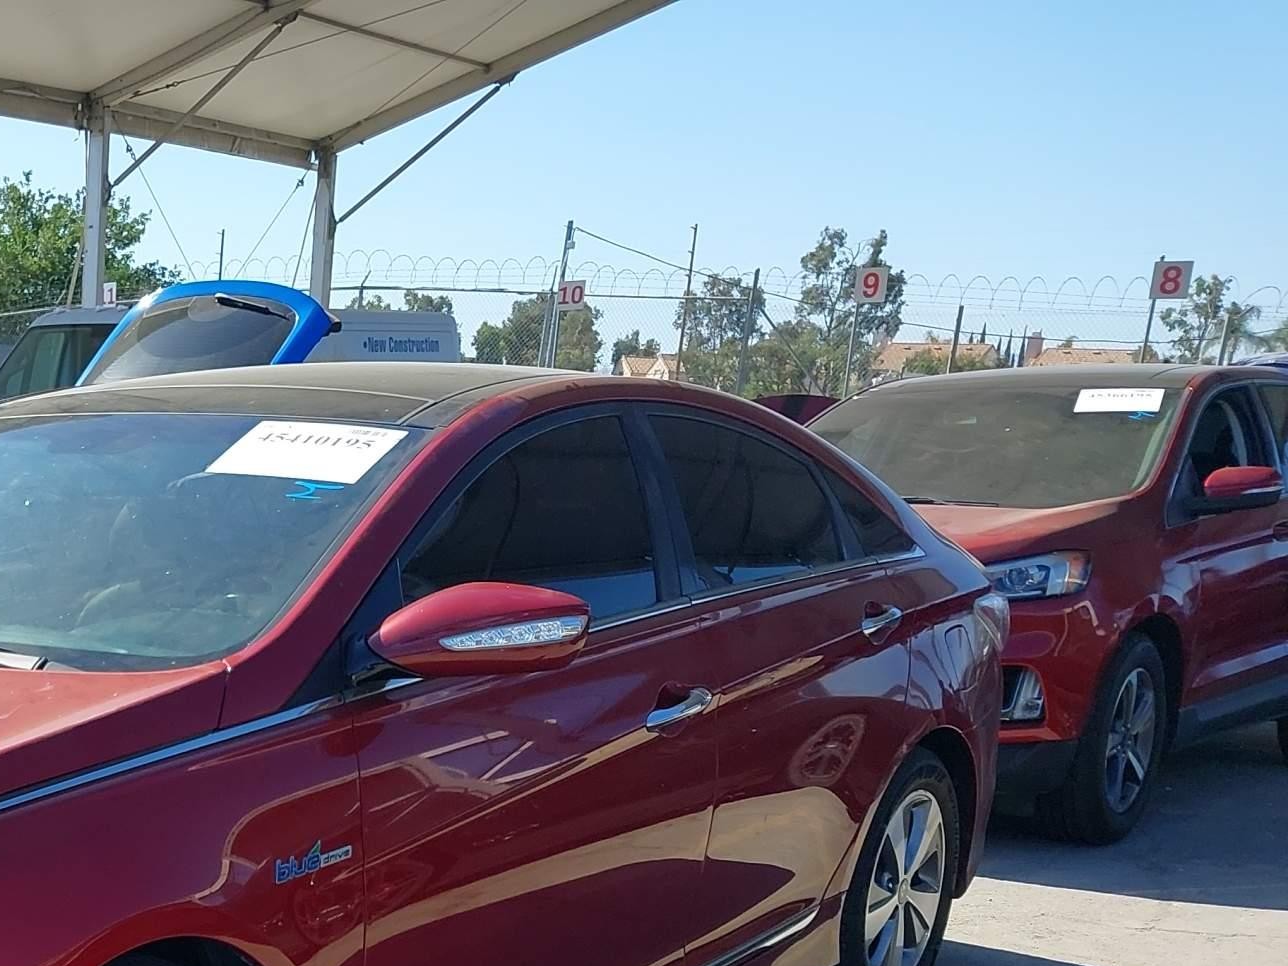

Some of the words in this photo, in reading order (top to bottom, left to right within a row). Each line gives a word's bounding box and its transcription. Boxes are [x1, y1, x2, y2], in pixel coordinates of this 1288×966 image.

[863, 272, 880, 298] 9
[1159, 265, 1183, 295] 8
[558, 285, 584, 305] 10
[388, 336, 440, 353] Construction
[258, 432, 377, 450] 45410195
[275, 848, 321, 885] blue
[321, 847, 352, 866] drive
